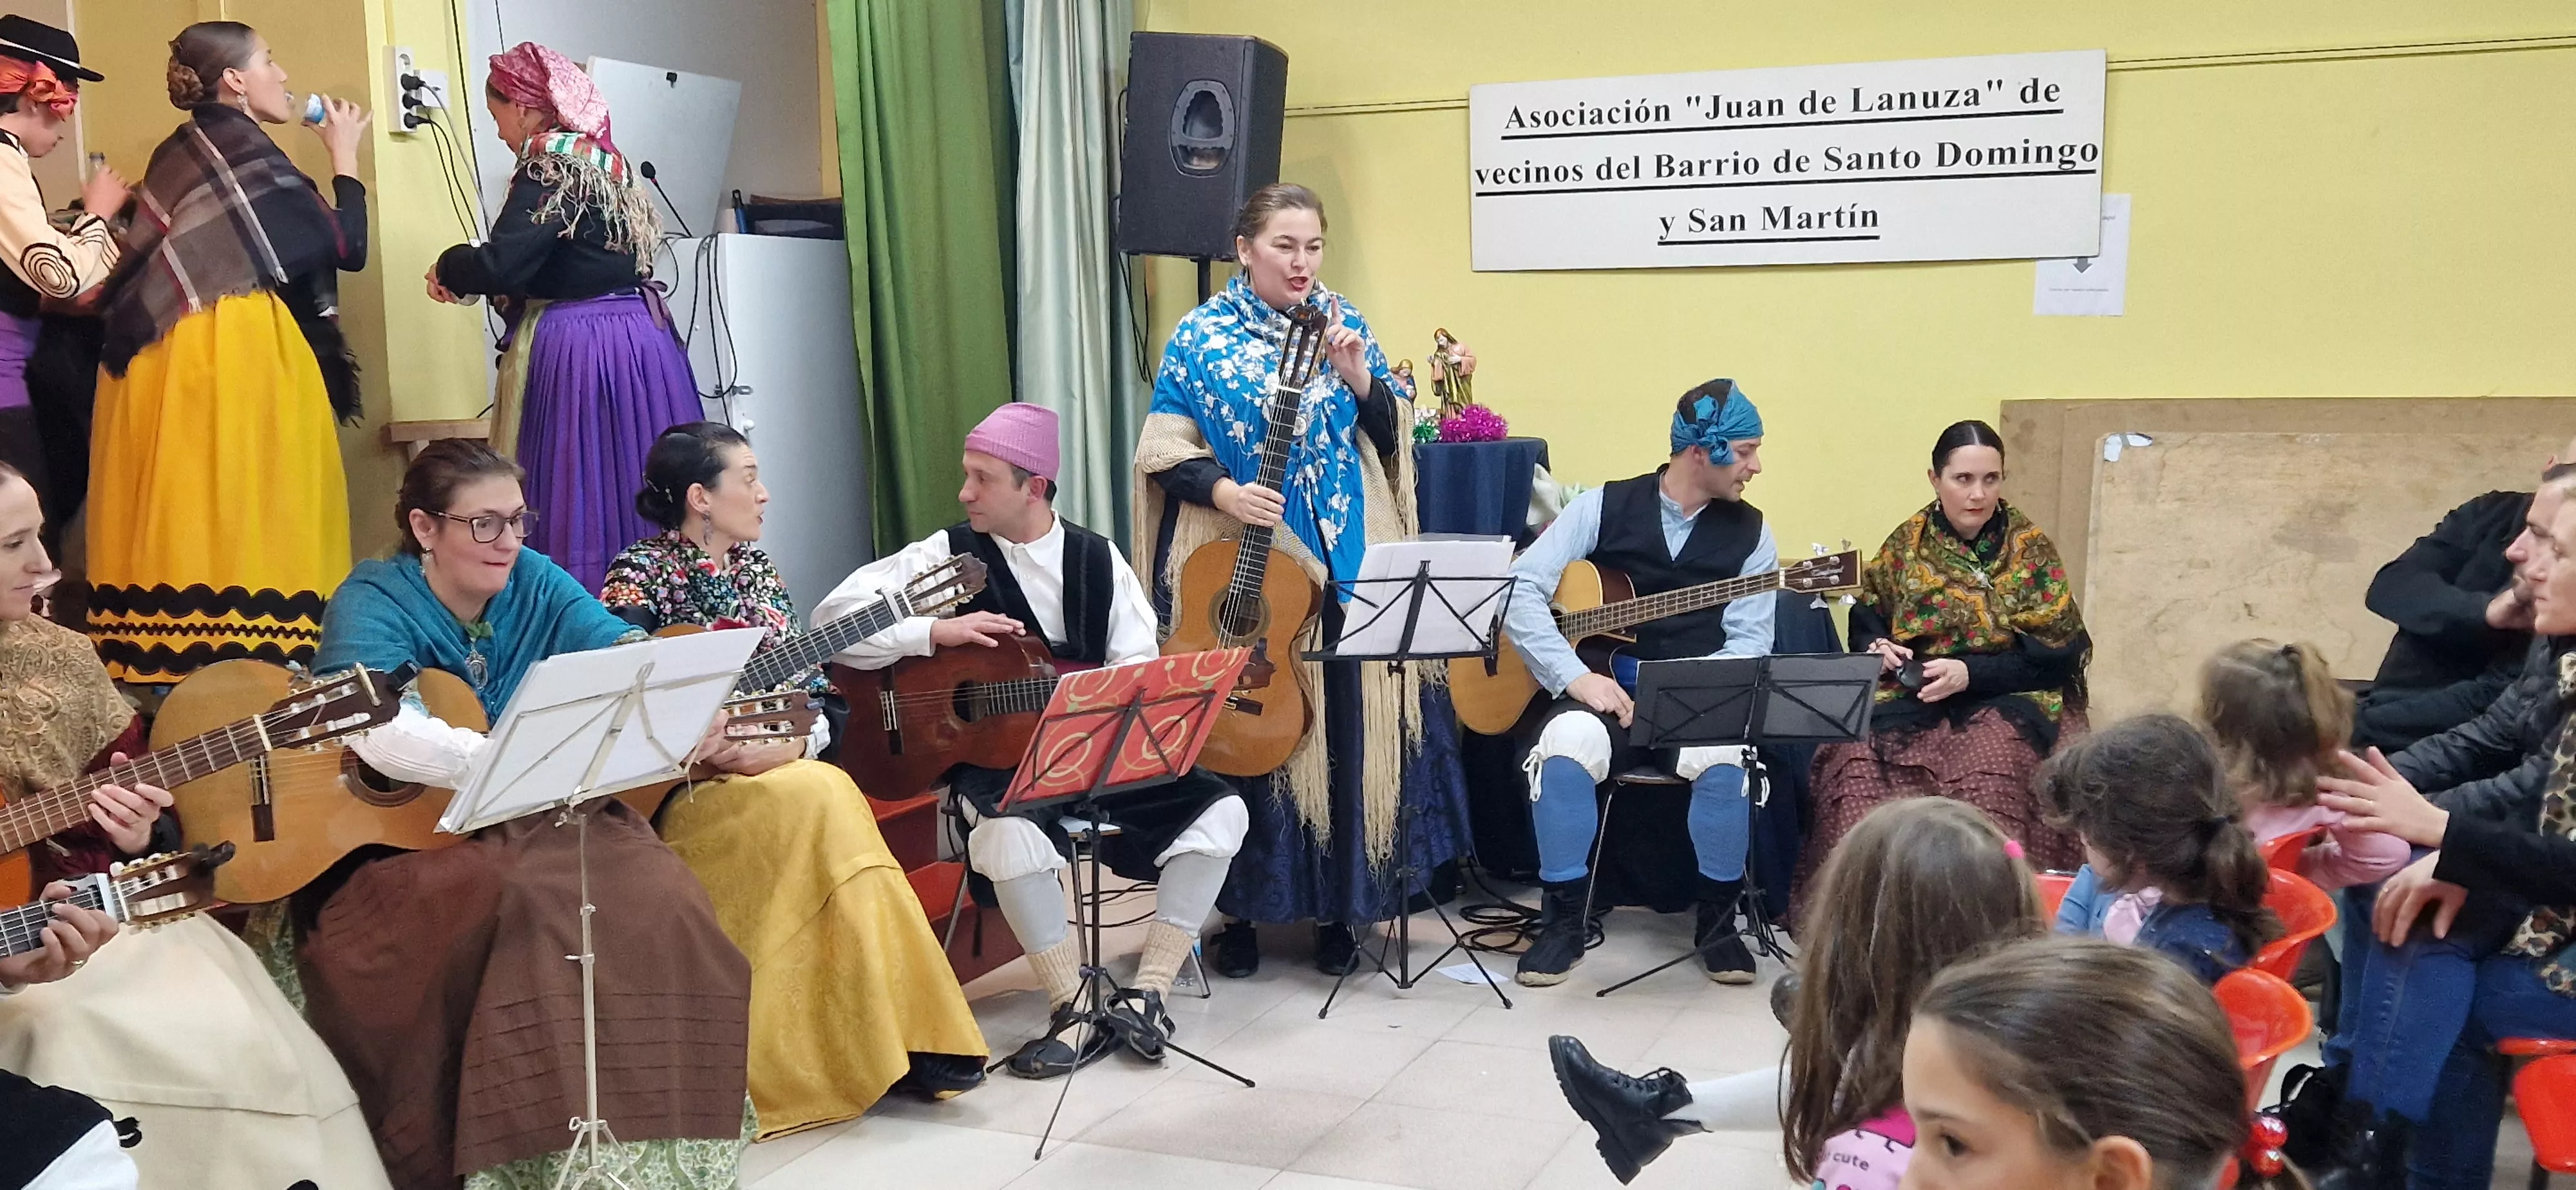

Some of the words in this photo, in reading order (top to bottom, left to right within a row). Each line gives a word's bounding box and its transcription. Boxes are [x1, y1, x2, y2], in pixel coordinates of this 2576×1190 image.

[1504, 98, 1670, 129] Asociación
[1686, 94, 1784, 120] "Juan
[1797, 90, 1836, 116] de
[1851, 79, 2003, 113] Lanuza"
[2019, 77, 2061, 107] de
[1475, 156, 1585, 185] vecinos
[1595, 153, 1640, 181] del
[1655, 151, 1759, 178] Barrio
[1773, 148, 1810, 175] de
[1823, 146, 1922, 172] Santo
[1937, 138, 2099, 171] Domingo
[1658, 216, 1676, 241] y
[1688, 208, 1746, 233] San
[1761, 202, 1879, 231] Martín
[1833, 1153, 1869, 1171] cute
